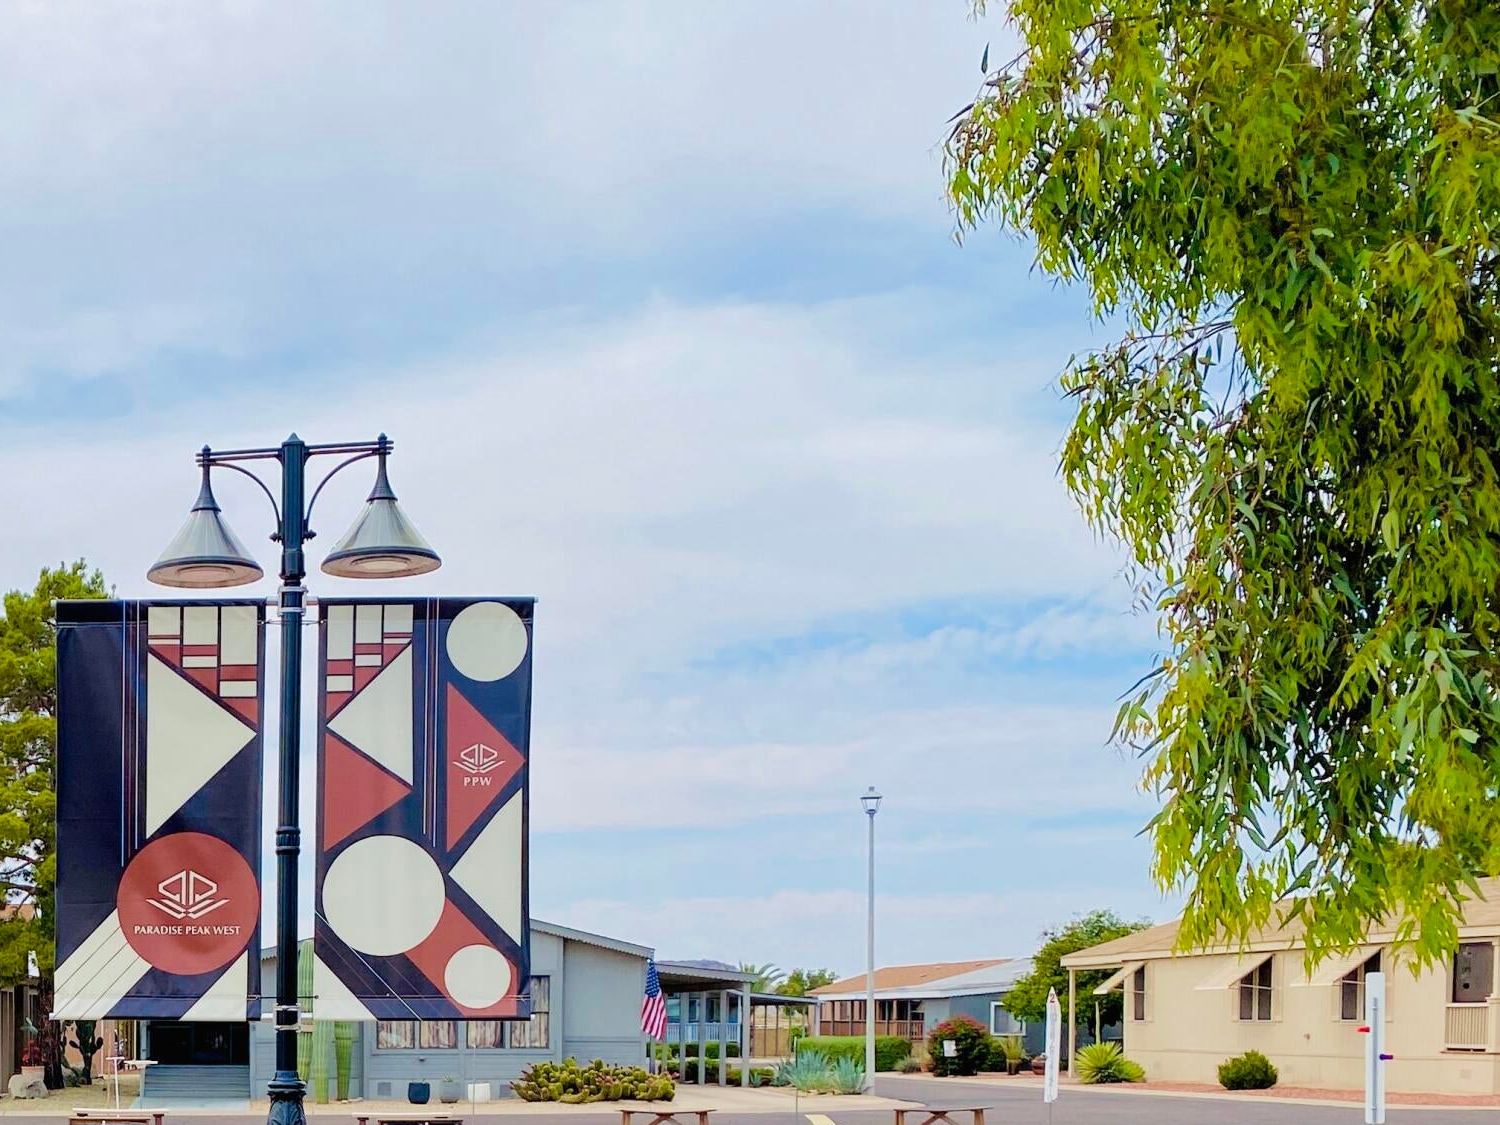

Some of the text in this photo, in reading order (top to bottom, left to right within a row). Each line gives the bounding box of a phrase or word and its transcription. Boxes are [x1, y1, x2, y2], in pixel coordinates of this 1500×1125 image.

[463, 776, 492, 786] PPW
[134, 925, 241, 935] PARADISE PEAK WEST
